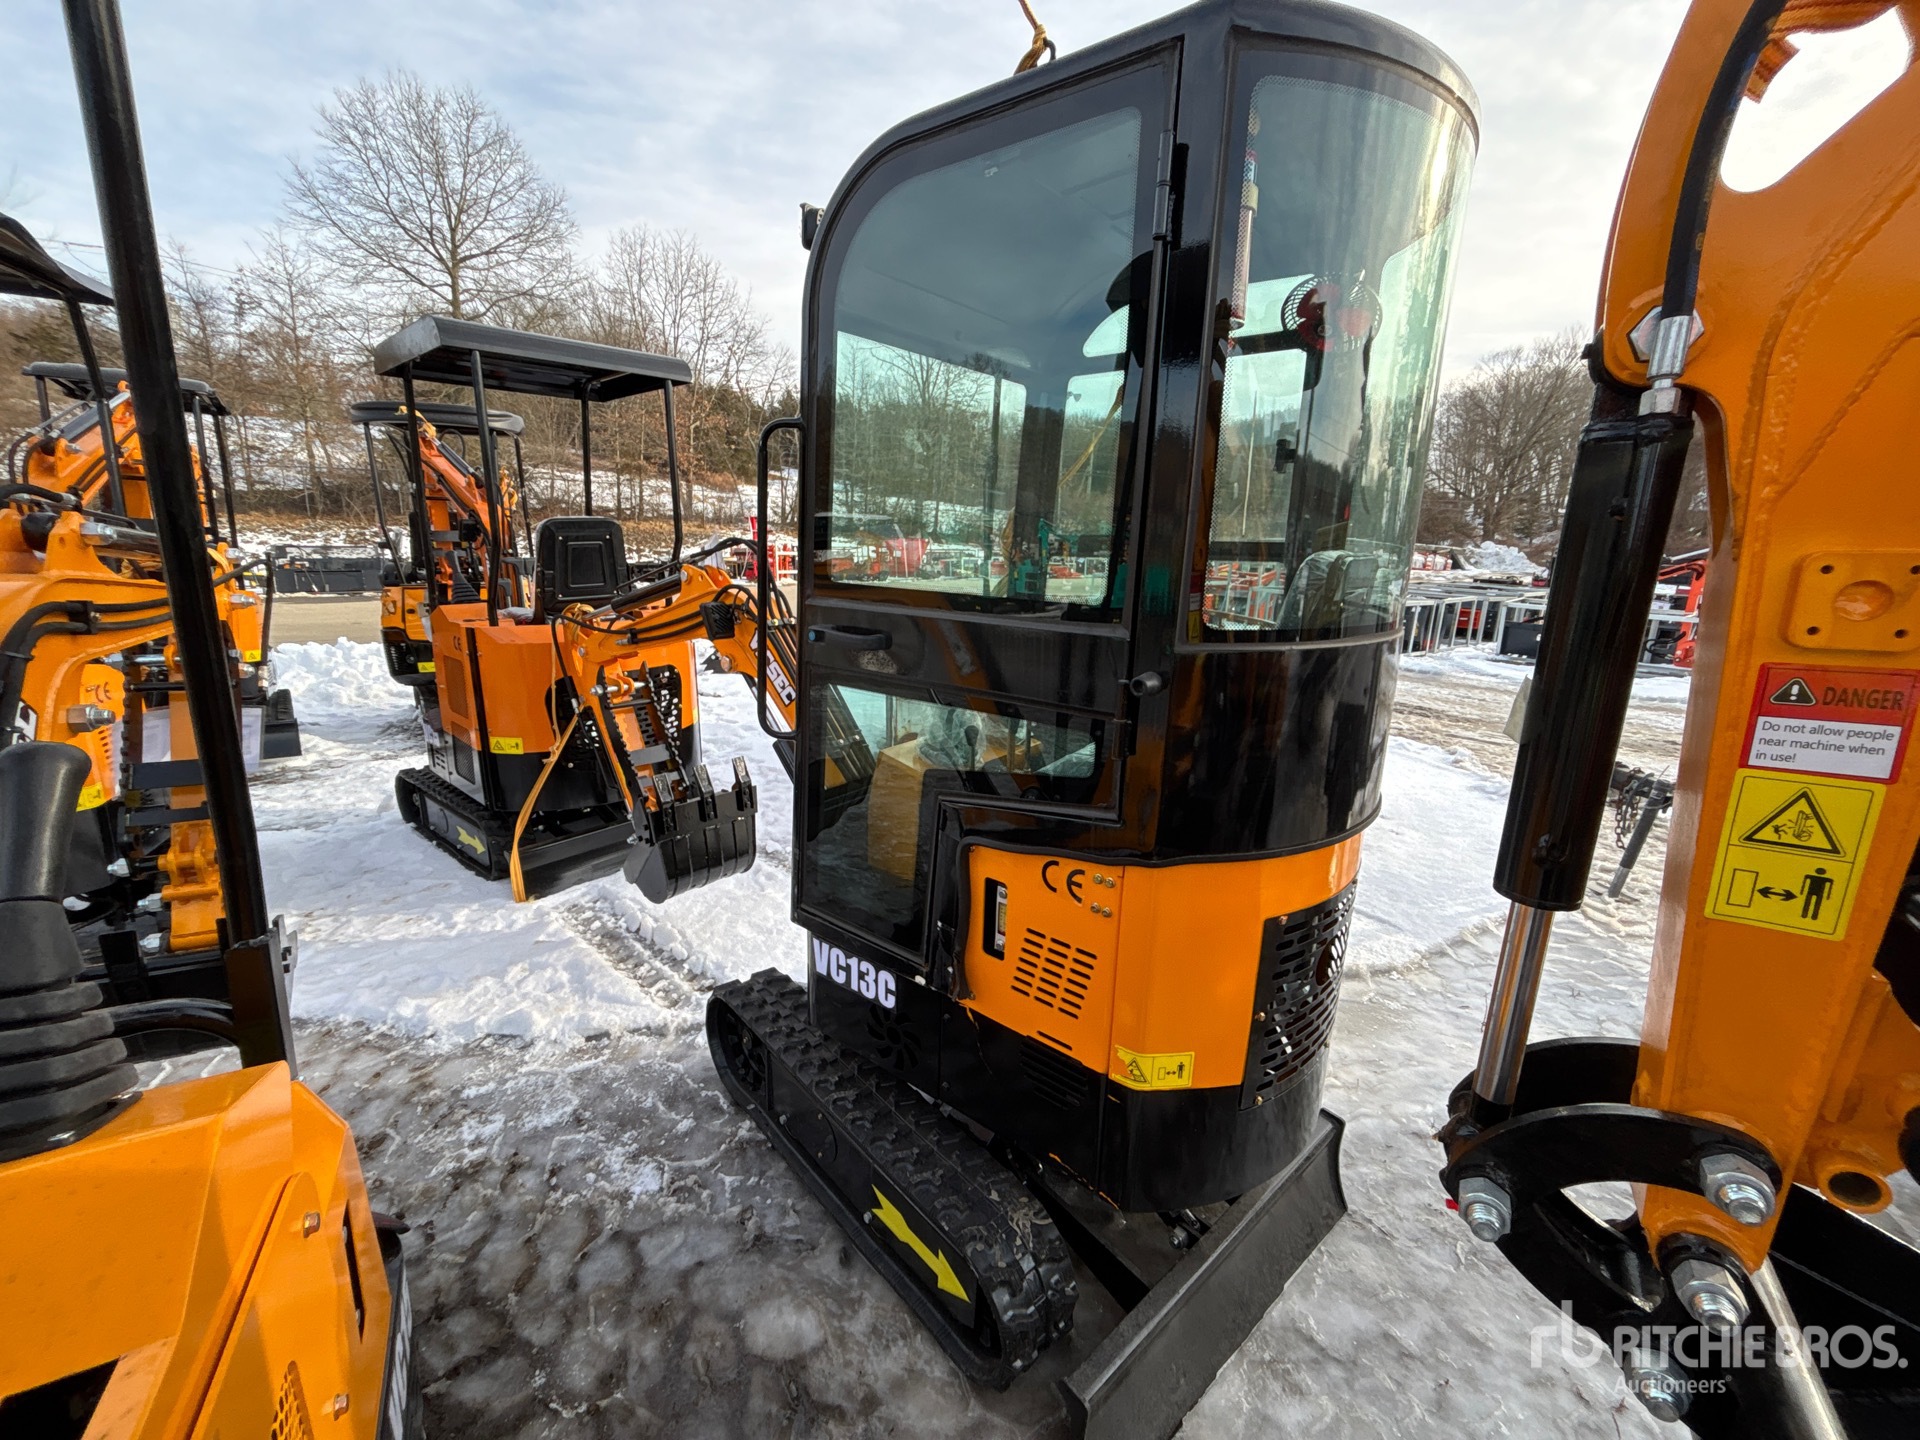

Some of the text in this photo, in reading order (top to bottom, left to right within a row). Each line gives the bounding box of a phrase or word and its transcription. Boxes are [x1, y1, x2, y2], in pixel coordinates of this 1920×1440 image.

[1822, 686, 1905, 711] DANGER
[1761, 720, 1895, 743] Do not allow people
[1755, 750, 1797, 763] in use!
[1758, 737, 1886, 756] near machine when
[1042, 859, 1086, 904] CE
[813, 937, 896, 1009] VC13C
